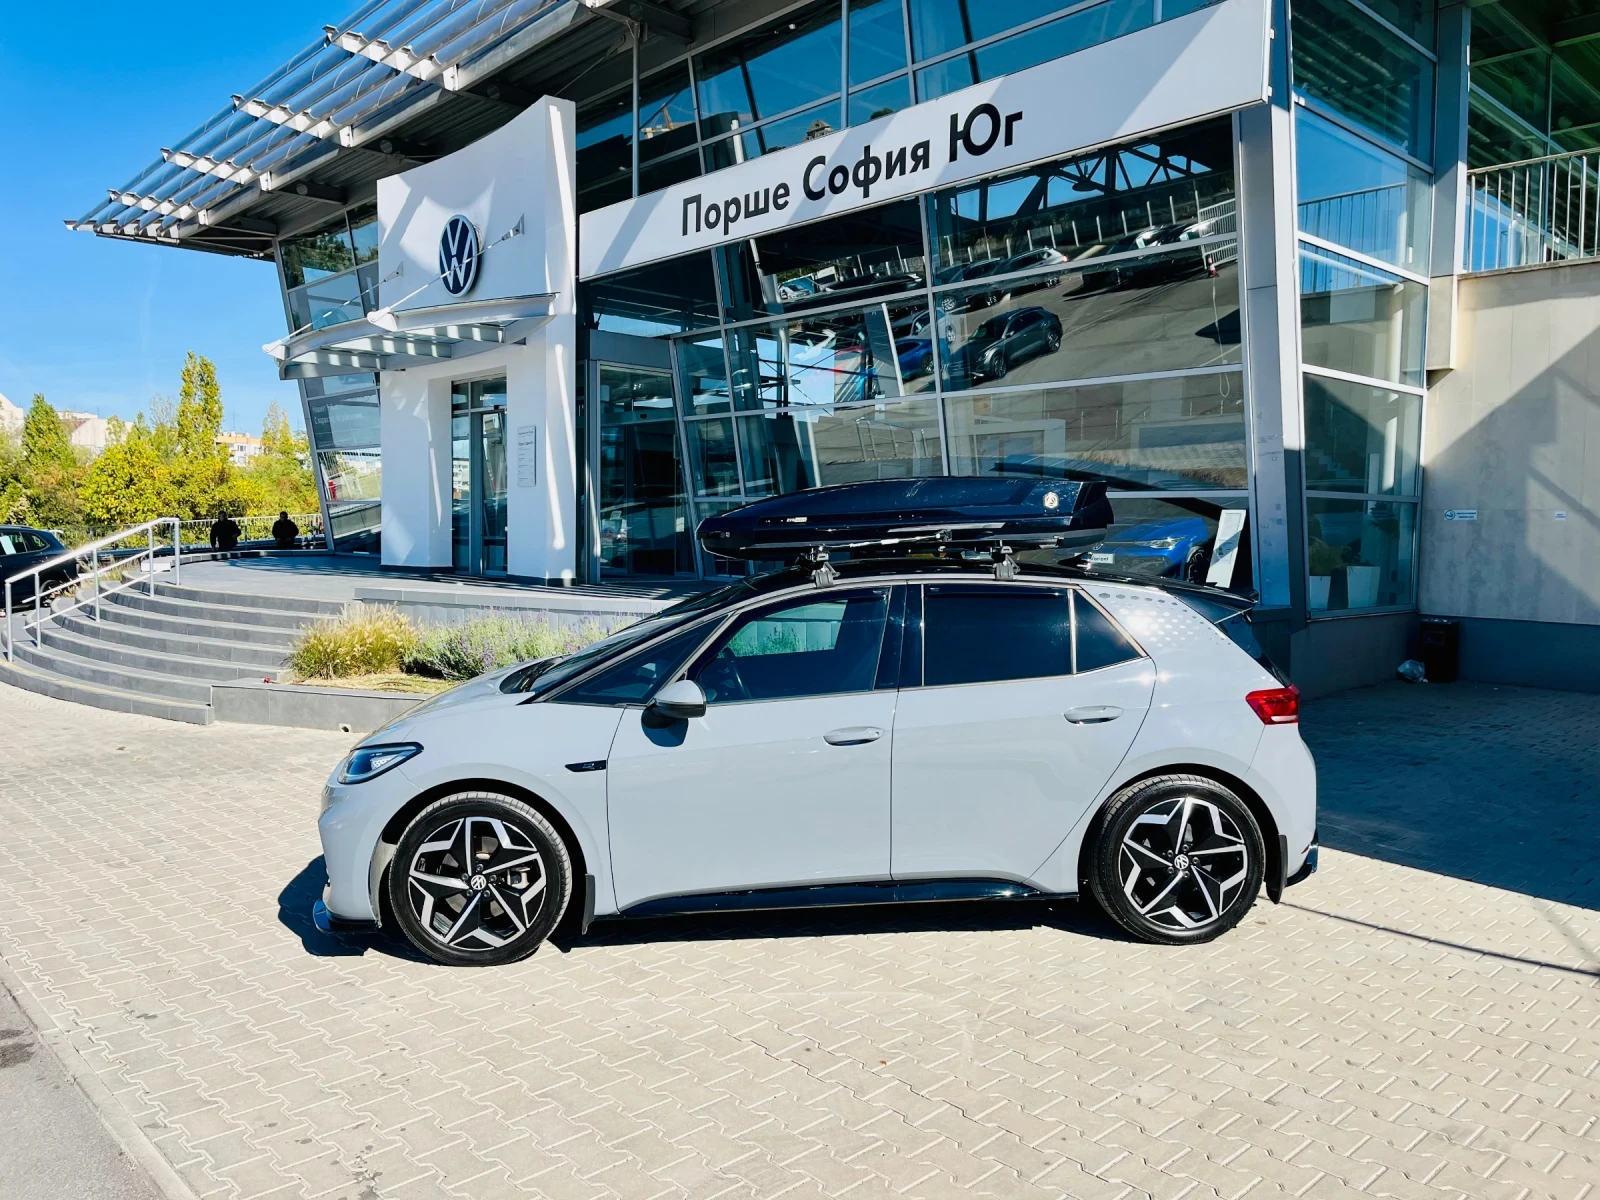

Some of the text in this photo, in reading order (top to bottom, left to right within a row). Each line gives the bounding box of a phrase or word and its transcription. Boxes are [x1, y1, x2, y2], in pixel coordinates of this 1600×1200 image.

[682, 102, 1023, 236] Порше София Юг
[439, 215, 477, 296] VW
